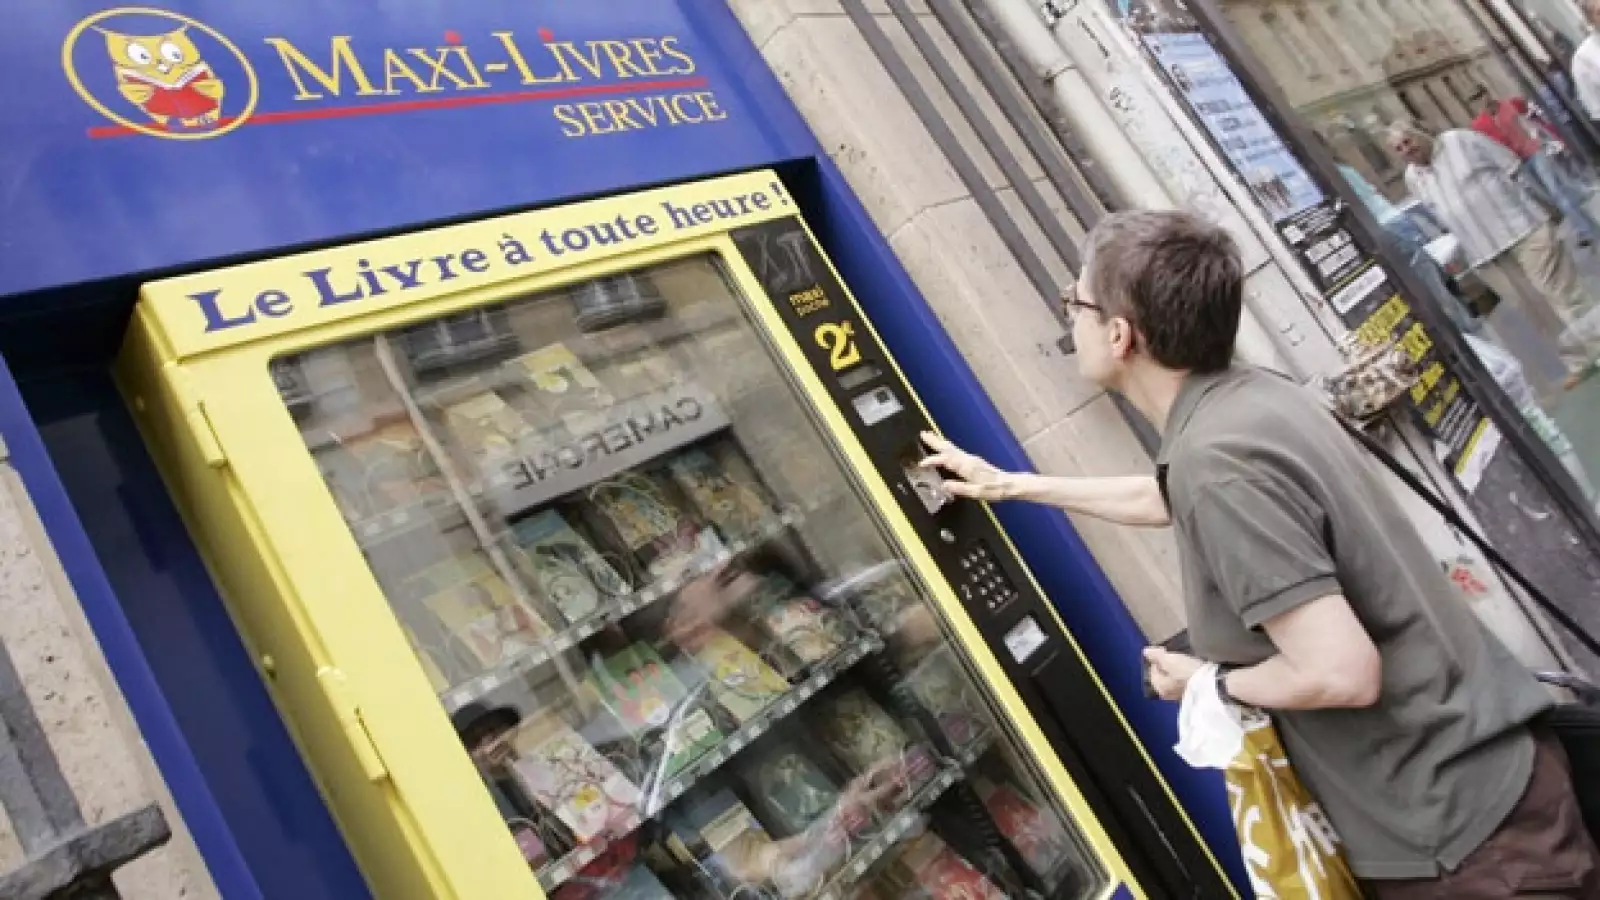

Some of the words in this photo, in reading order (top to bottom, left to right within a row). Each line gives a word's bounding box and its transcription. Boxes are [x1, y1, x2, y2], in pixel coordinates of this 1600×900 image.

[552, 91, 728, 137] SERVICE
[188, 285, 292, 334] Le
[300, 251, 486, 307] Livre
[500, 227, 532, 266] à
[538, 210, 660, 258] toute
